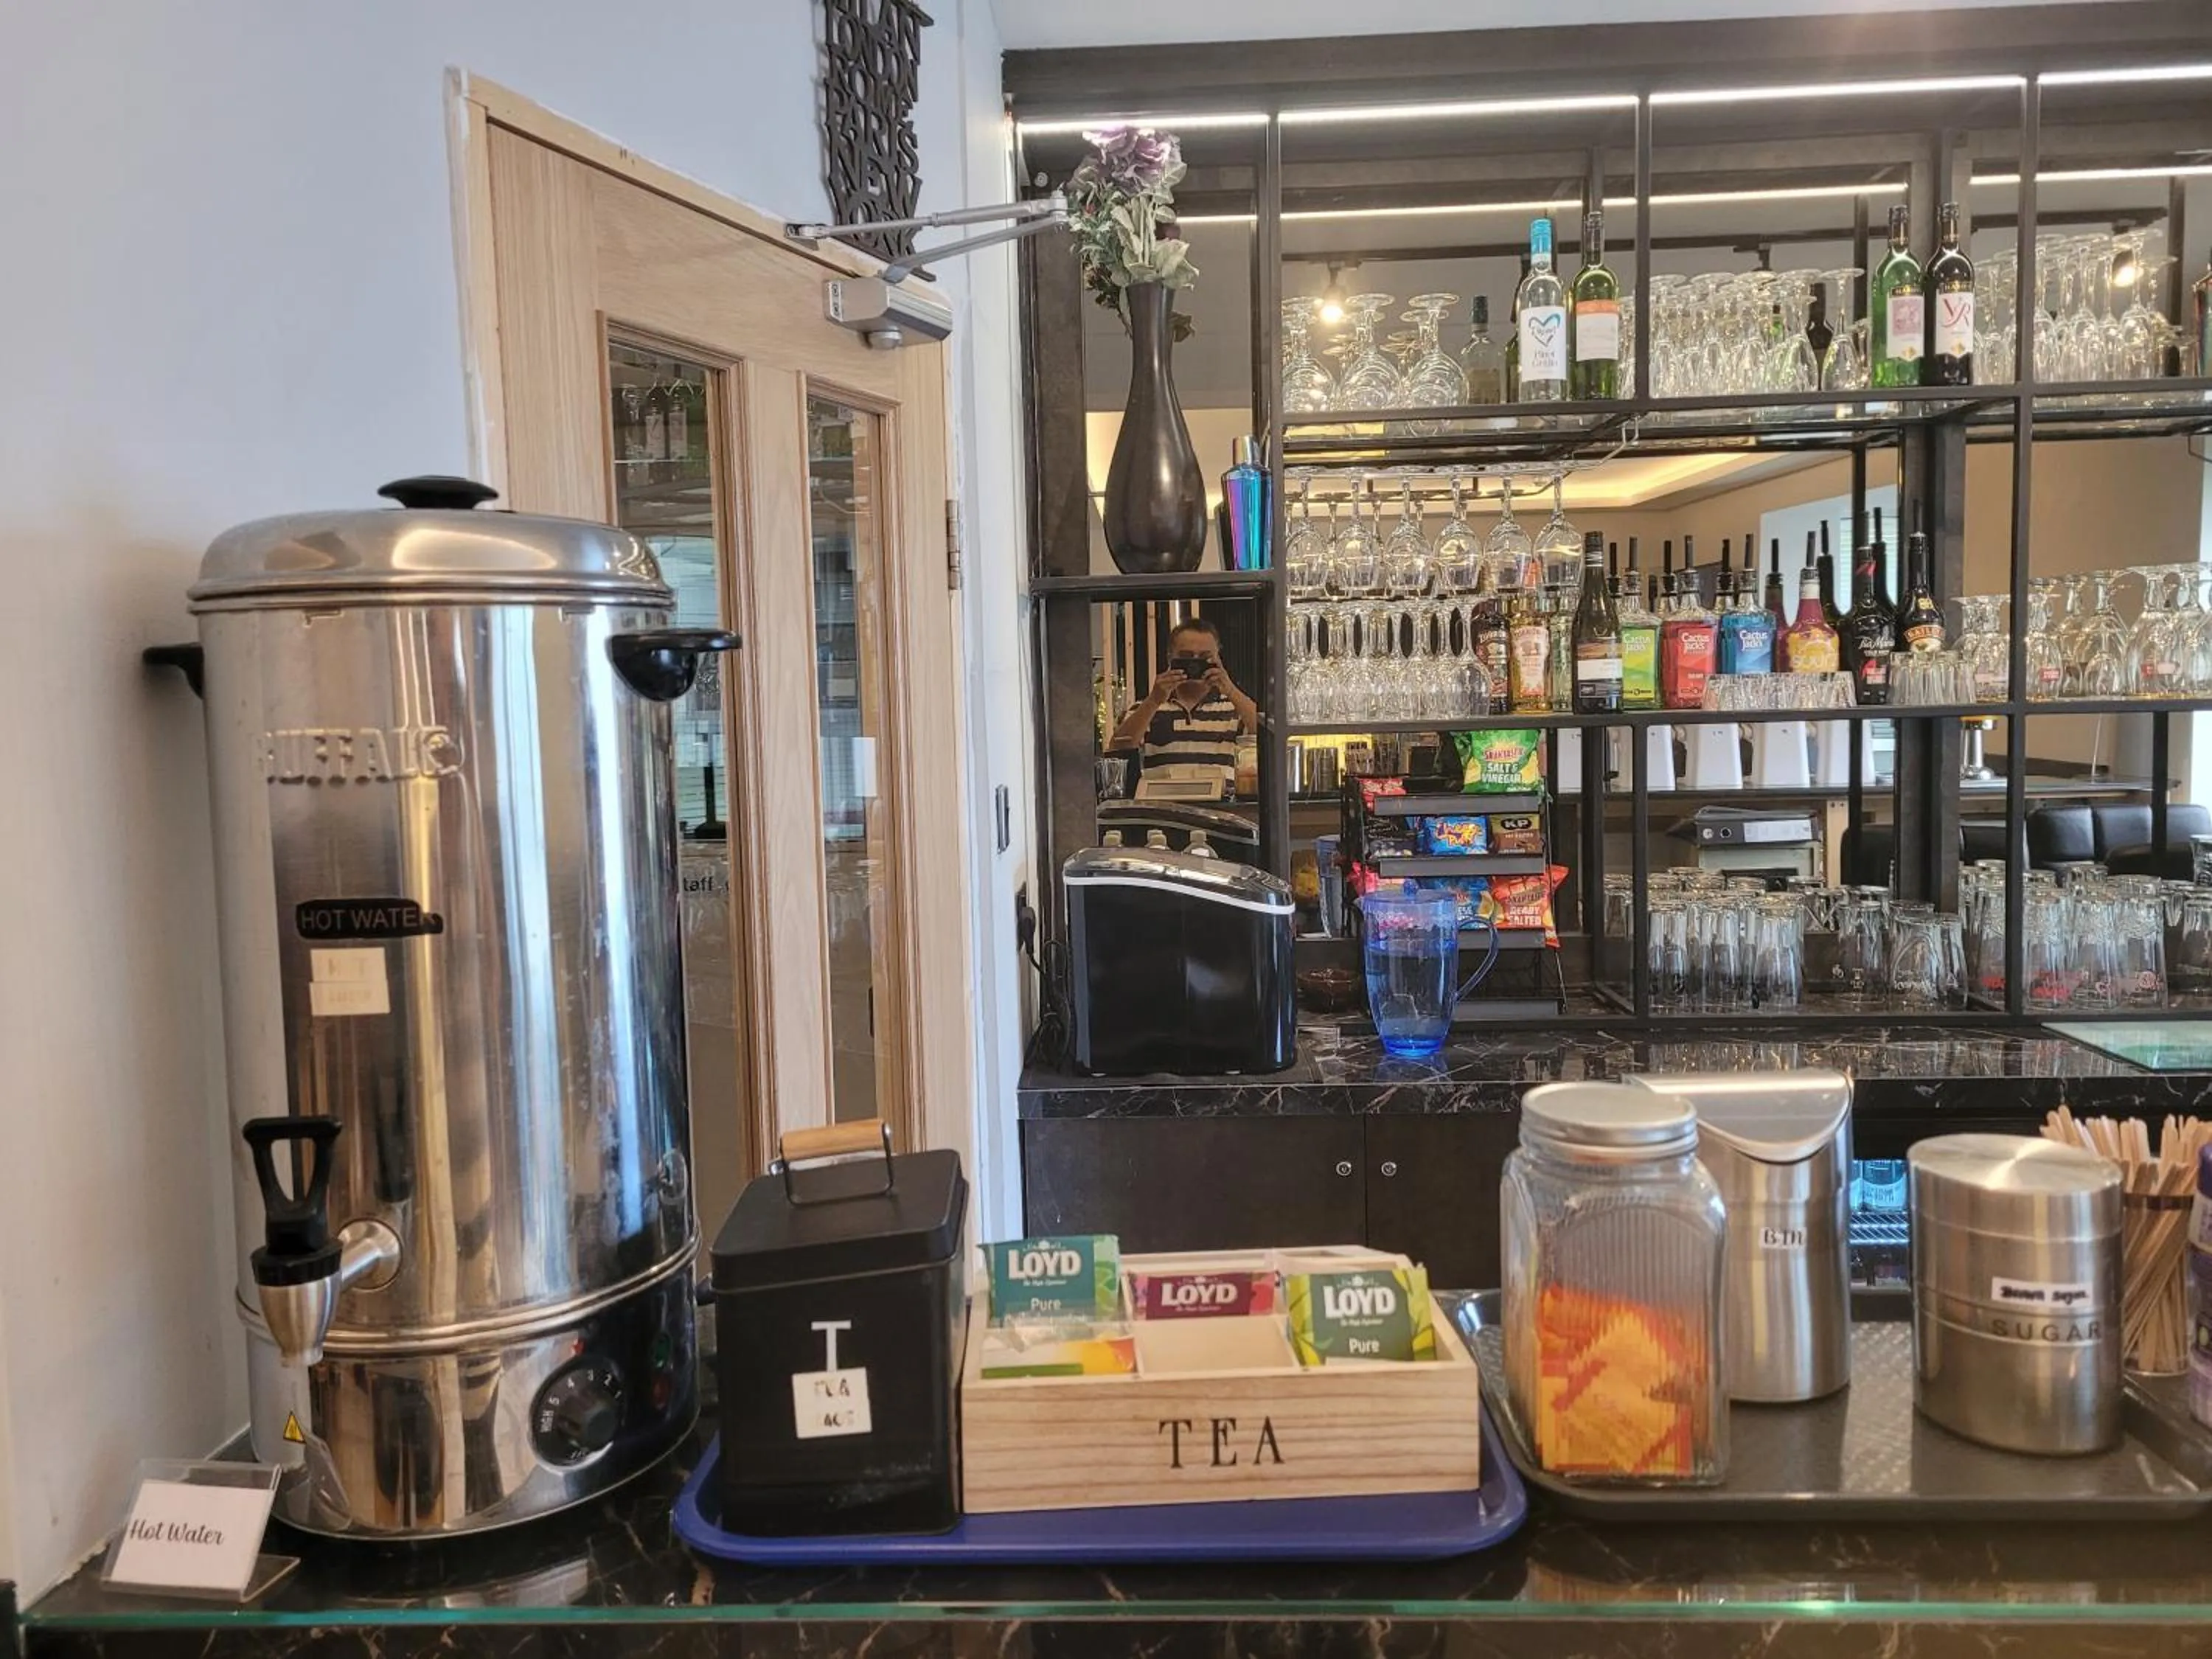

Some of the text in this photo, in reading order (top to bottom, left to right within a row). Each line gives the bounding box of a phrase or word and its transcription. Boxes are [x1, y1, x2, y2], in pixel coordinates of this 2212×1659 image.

[1682, 633, 1710, 643] Cactus
[1486, 762, 1511, 773] SALT
[1503, 819, 1529, 828] KP
[683, 876, 714, 891] taff
[300, 909, 344, 931] HOT
[1008, 1250, 1082, 1280] LOYD
[1031, 1298, 1062, 1312] Pure
[1161, 1282, 1238, 1307] LOYD
[1324, 1285, 1397, 1318] LOYD
[1992, 1319, 2101, 1343] SUGAR
[812, 1320, 852, 1373] T
[1349, 1338, 1380, 1354] Pure
[604, 1374, 612, 1386] 2
[1158, 1416, 1285, 1470] TEA
[130, 1519, 225, 1545] Hot Water
